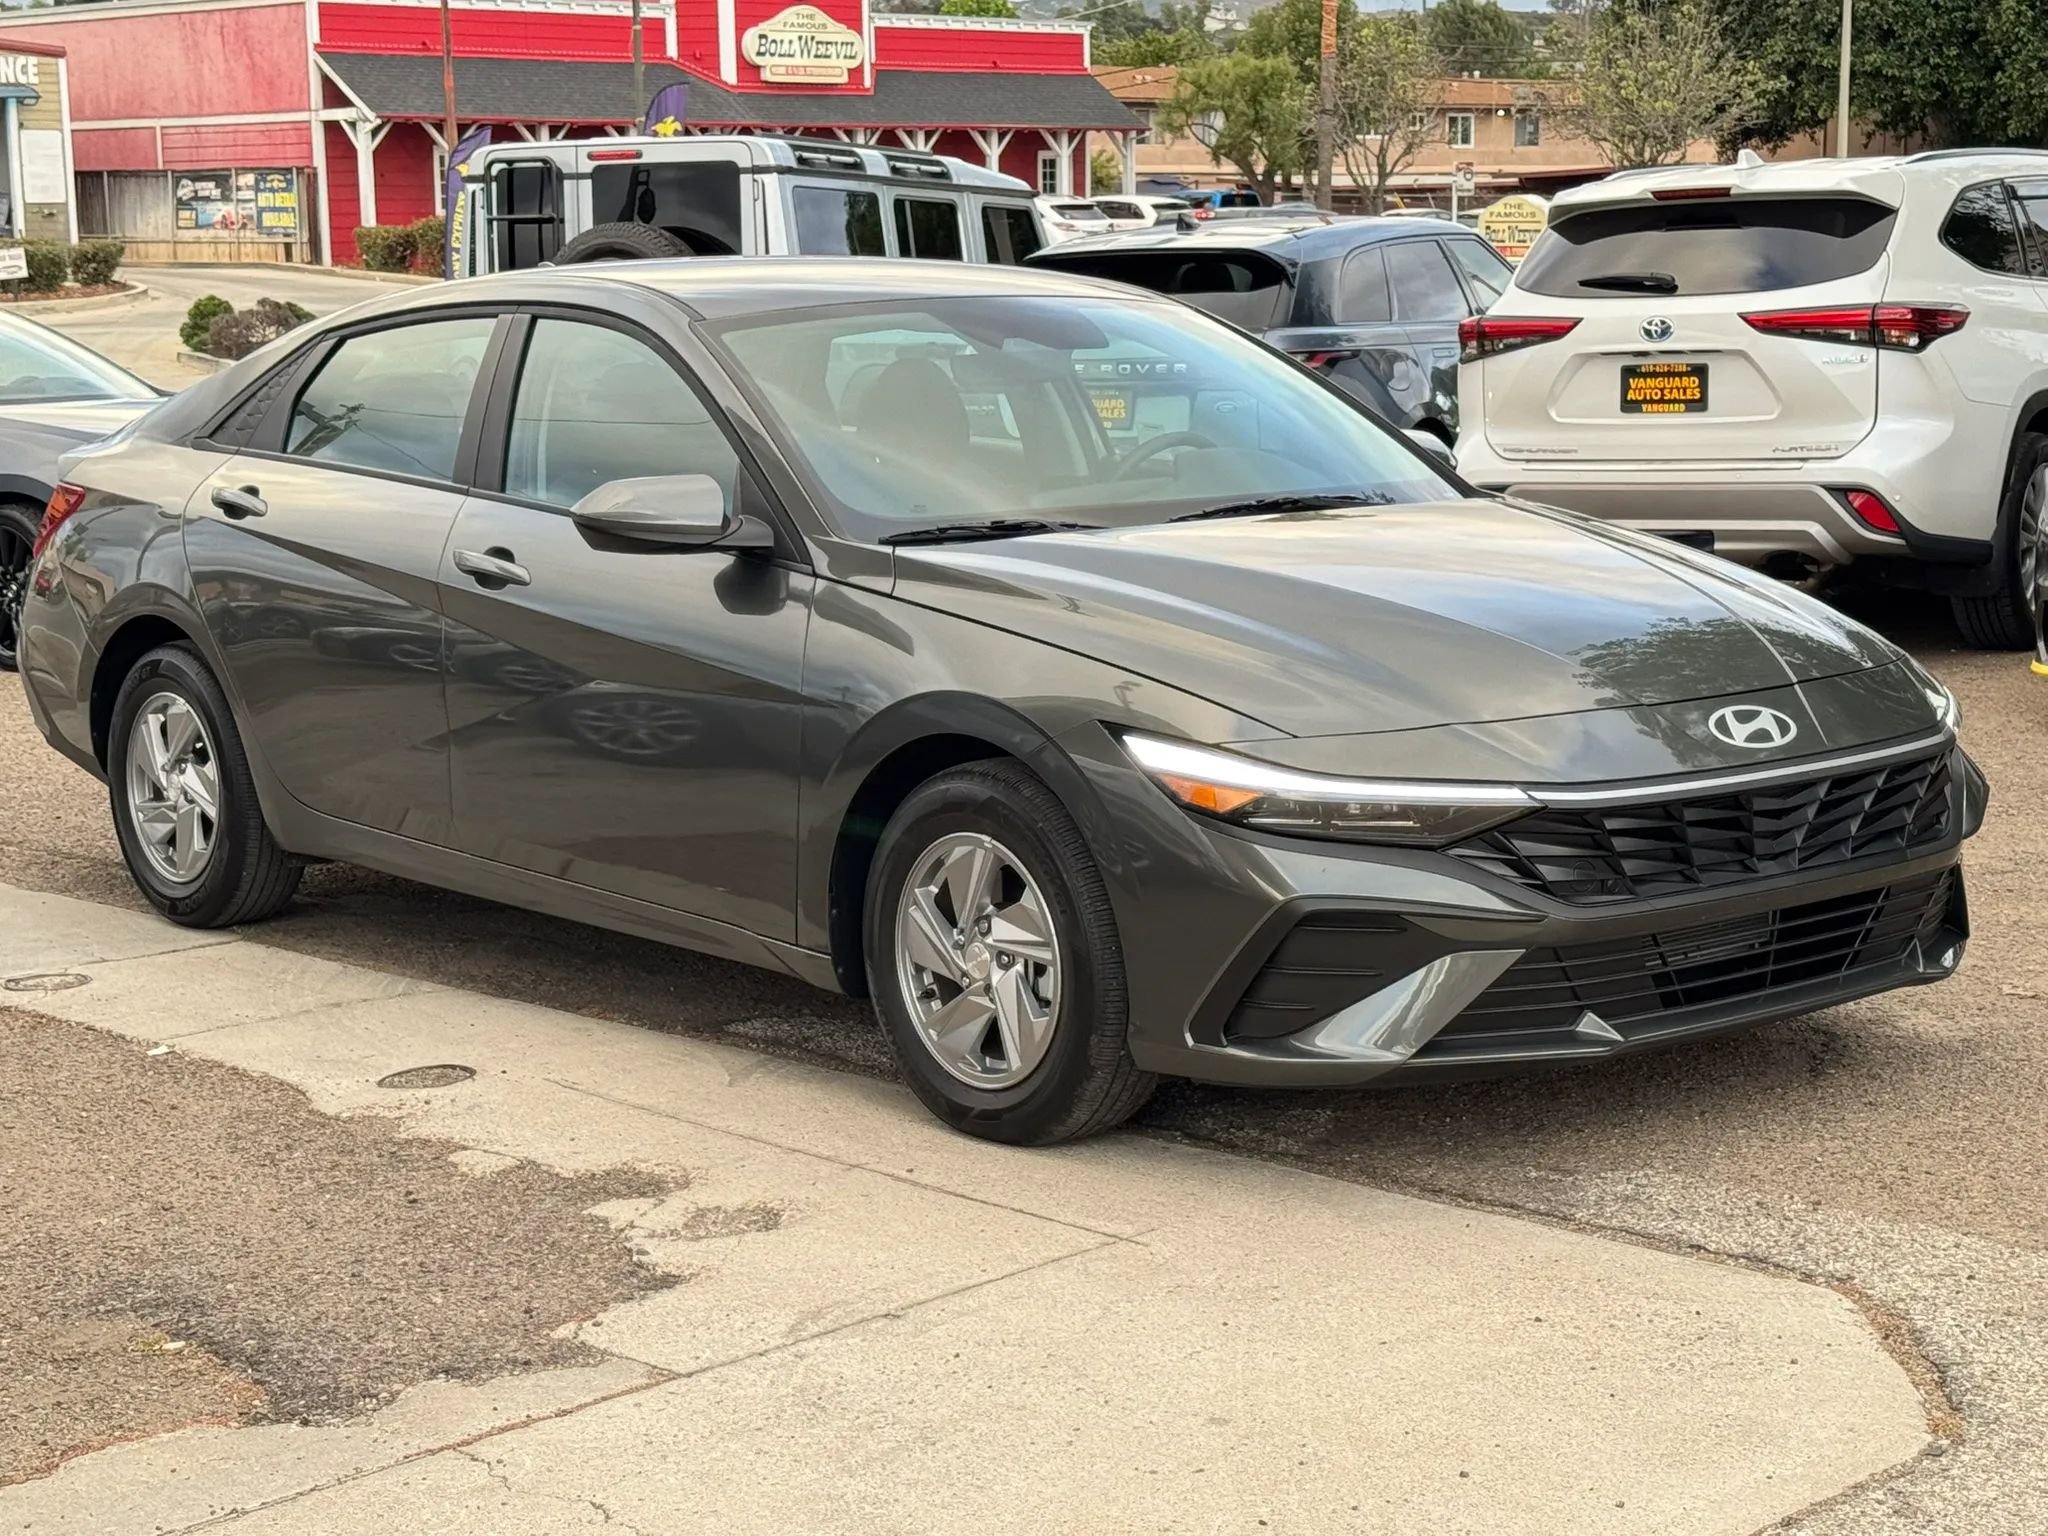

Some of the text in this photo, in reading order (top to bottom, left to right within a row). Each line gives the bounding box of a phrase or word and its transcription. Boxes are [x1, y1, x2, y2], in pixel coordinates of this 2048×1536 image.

[783, 21, 828, 30] FAMOUS
[756, 34, 857, 59] BOLL WEEVIL
[1489, 211, 1536, 219] FAMOUS
[1101, 364, 1187, 374] ROVER
[1629, 377, 1700, 388] VANGUARD
[1627, 388, 1701, 400] AUTO SALES
[1641, 403, 1686, 412] VANGUARD
